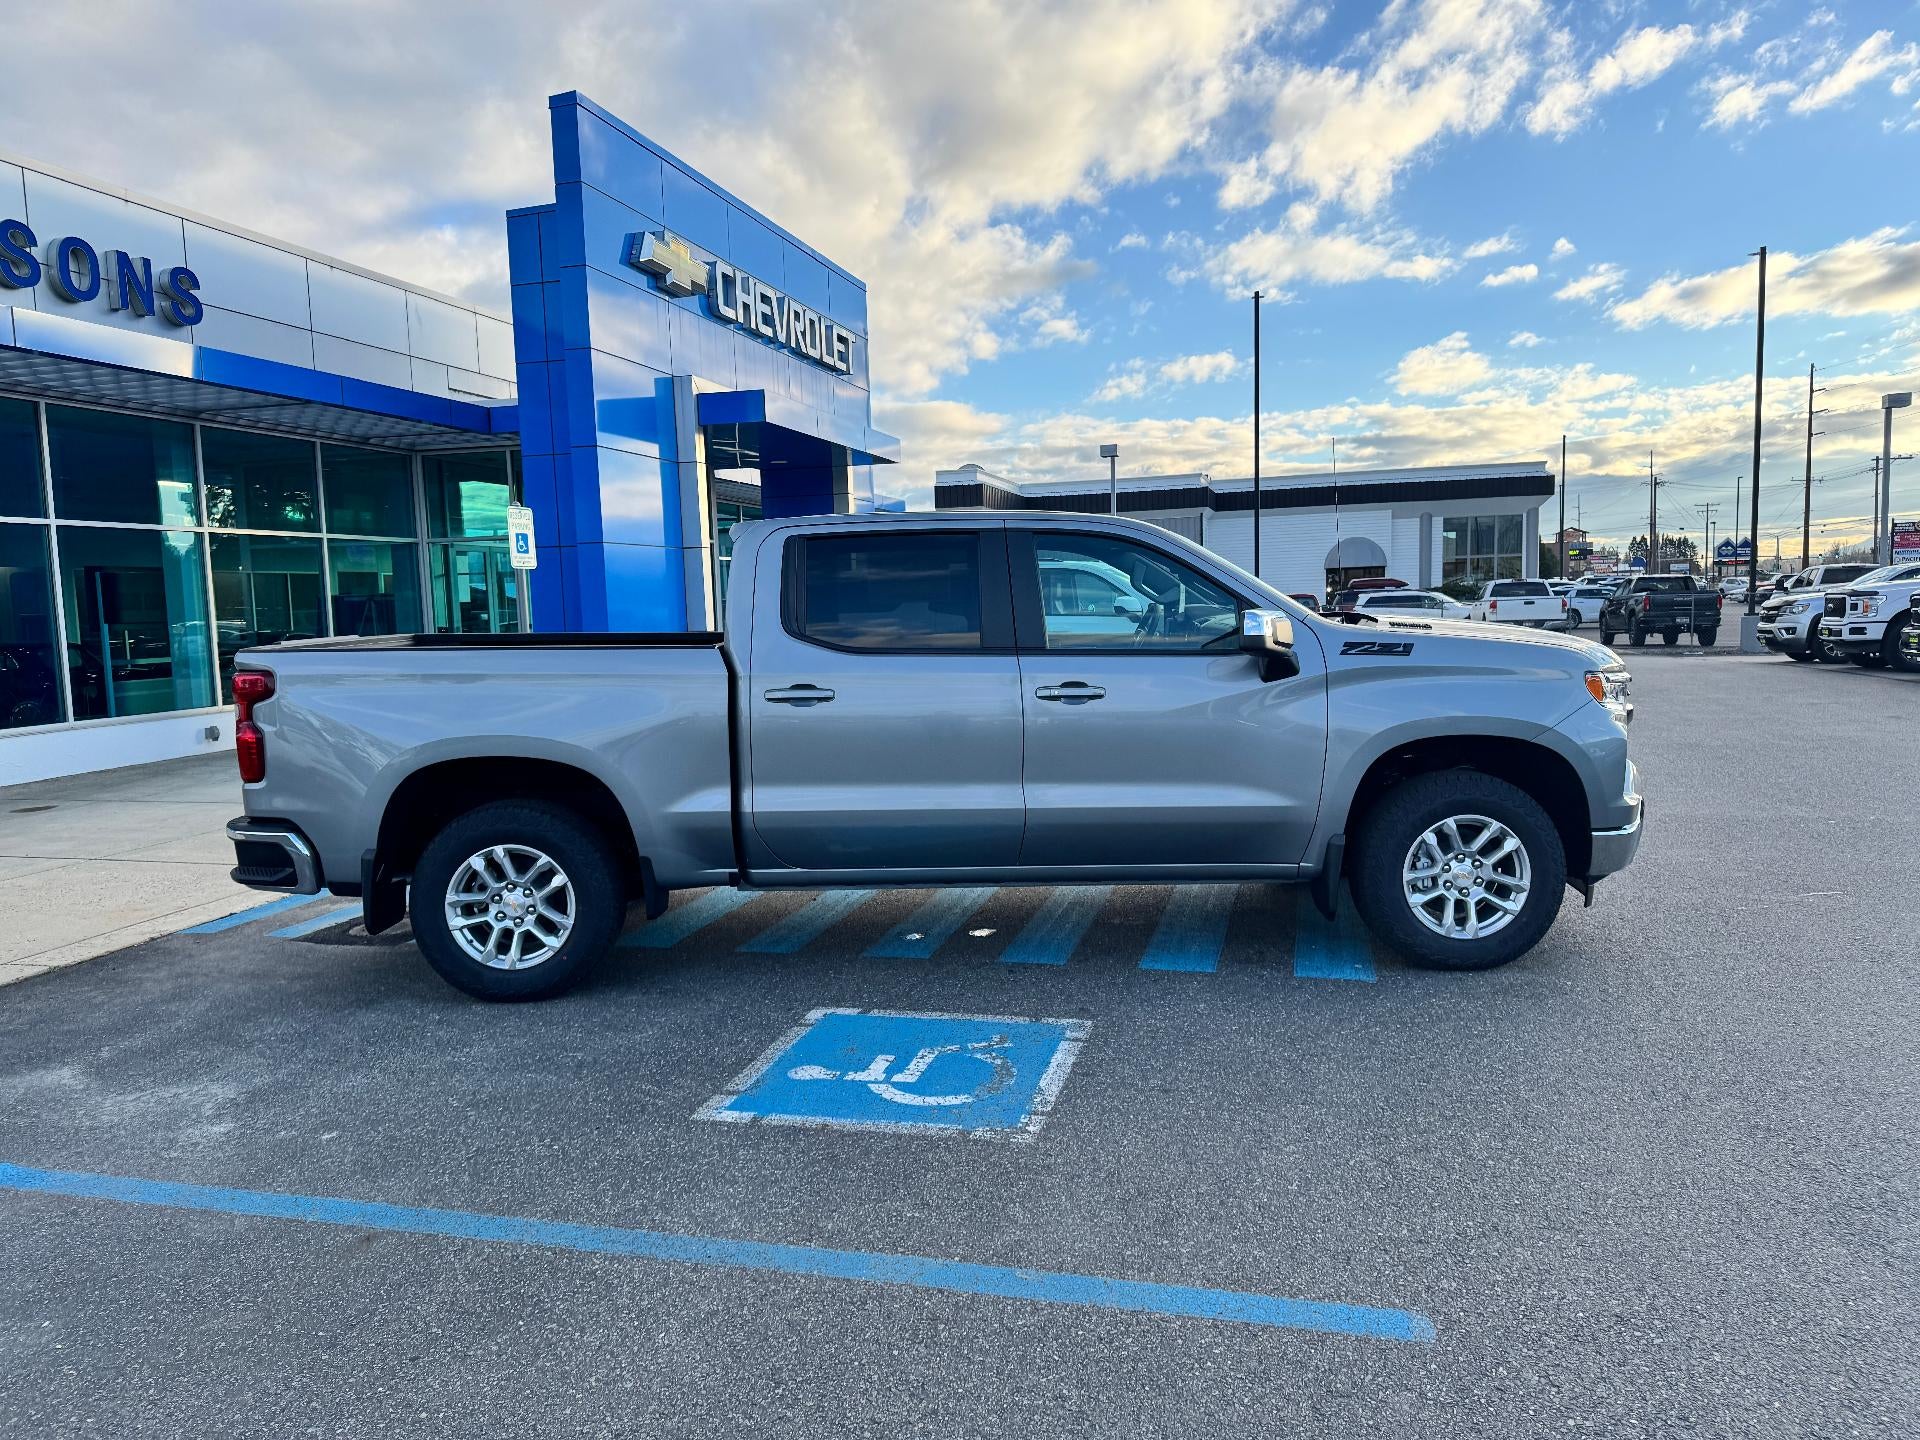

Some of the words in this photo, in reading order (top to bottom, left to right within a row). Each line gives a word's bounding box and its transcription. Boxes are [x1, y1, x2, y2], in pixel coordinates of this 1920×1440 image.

[711, 261, 856, 375] CHEVROLET
[511, 522, 531, 531] PARKING
[1340, 641, 1414, 656] Z71
